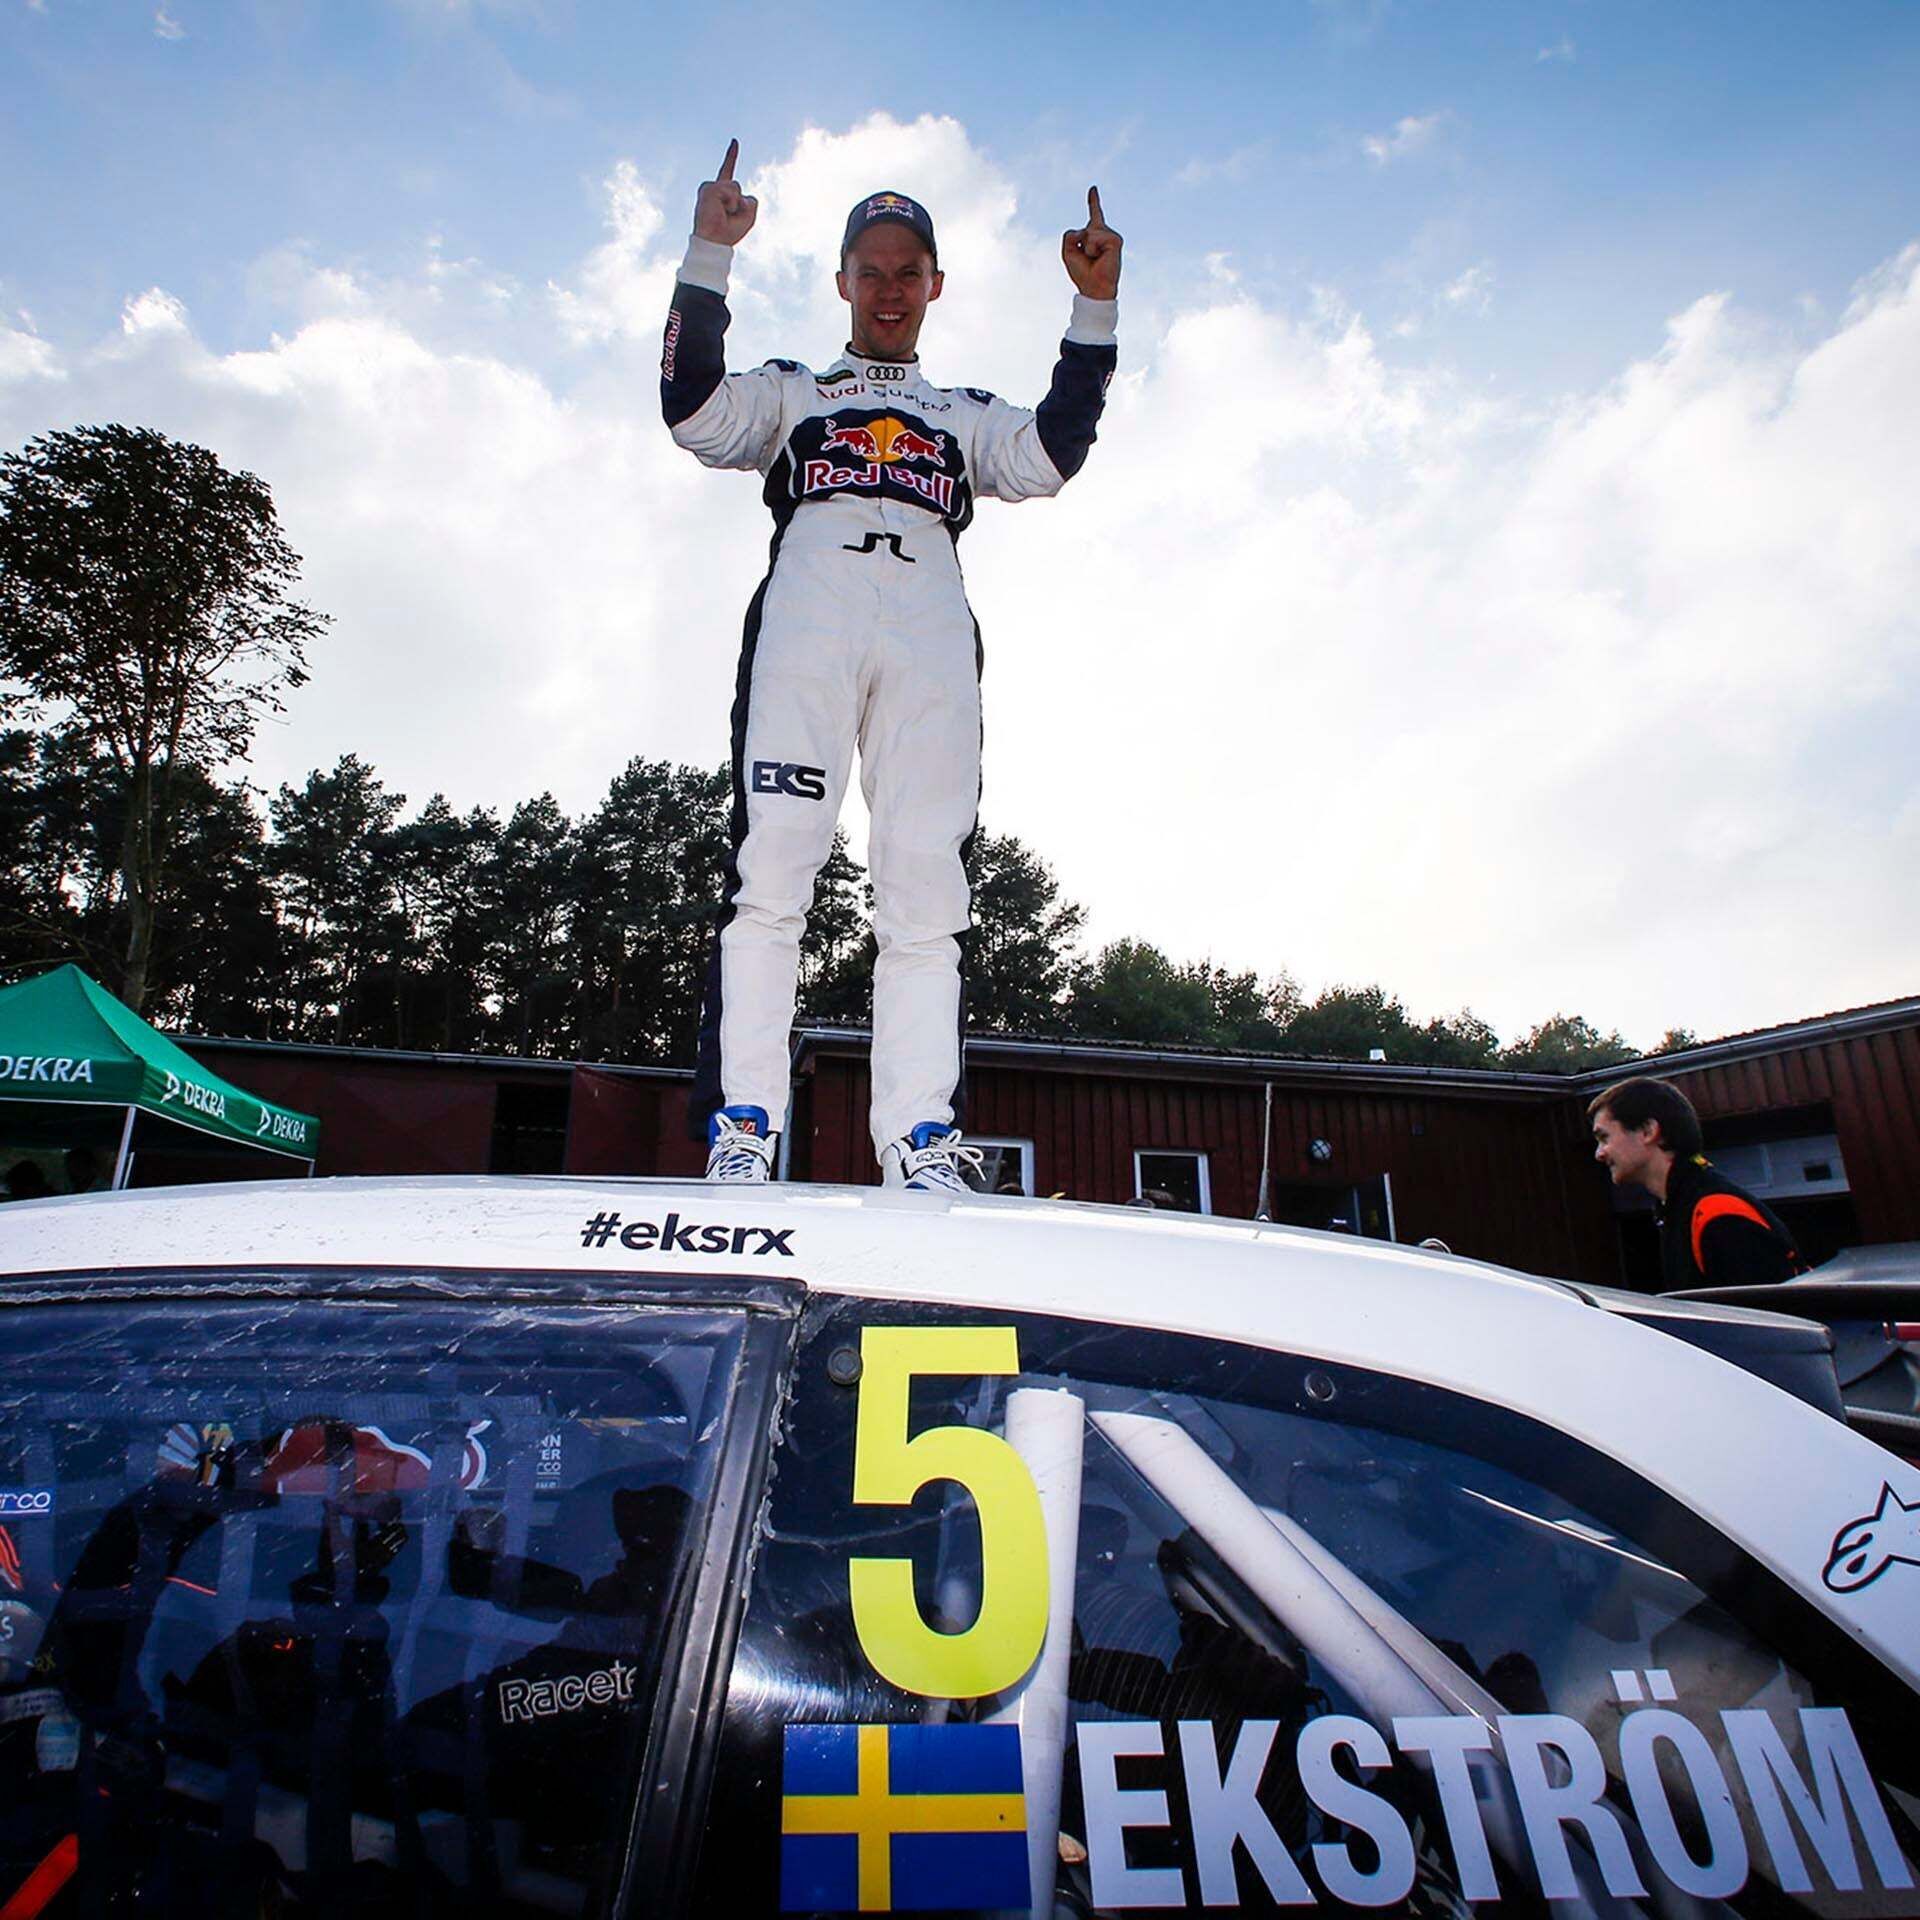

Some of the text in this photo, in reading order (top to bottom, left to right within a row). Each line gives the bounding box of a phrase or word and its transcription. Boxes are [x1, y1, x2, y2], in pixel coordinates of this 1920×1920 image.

[804, 459, 955, 514] Red Bull
[752, 760, 826, 801] EKS
[184, 1081, 225, 1119] DEKRA
[272, 1114, 306, 1143] DEKRA
[580, 1211, 796, 1257] #eksrx
[0, 1492, 51, 1510] rco
[849, 1326, 1050, 1700] 5
[1076, 1669, 1916, 1908] EKSTRÖM
